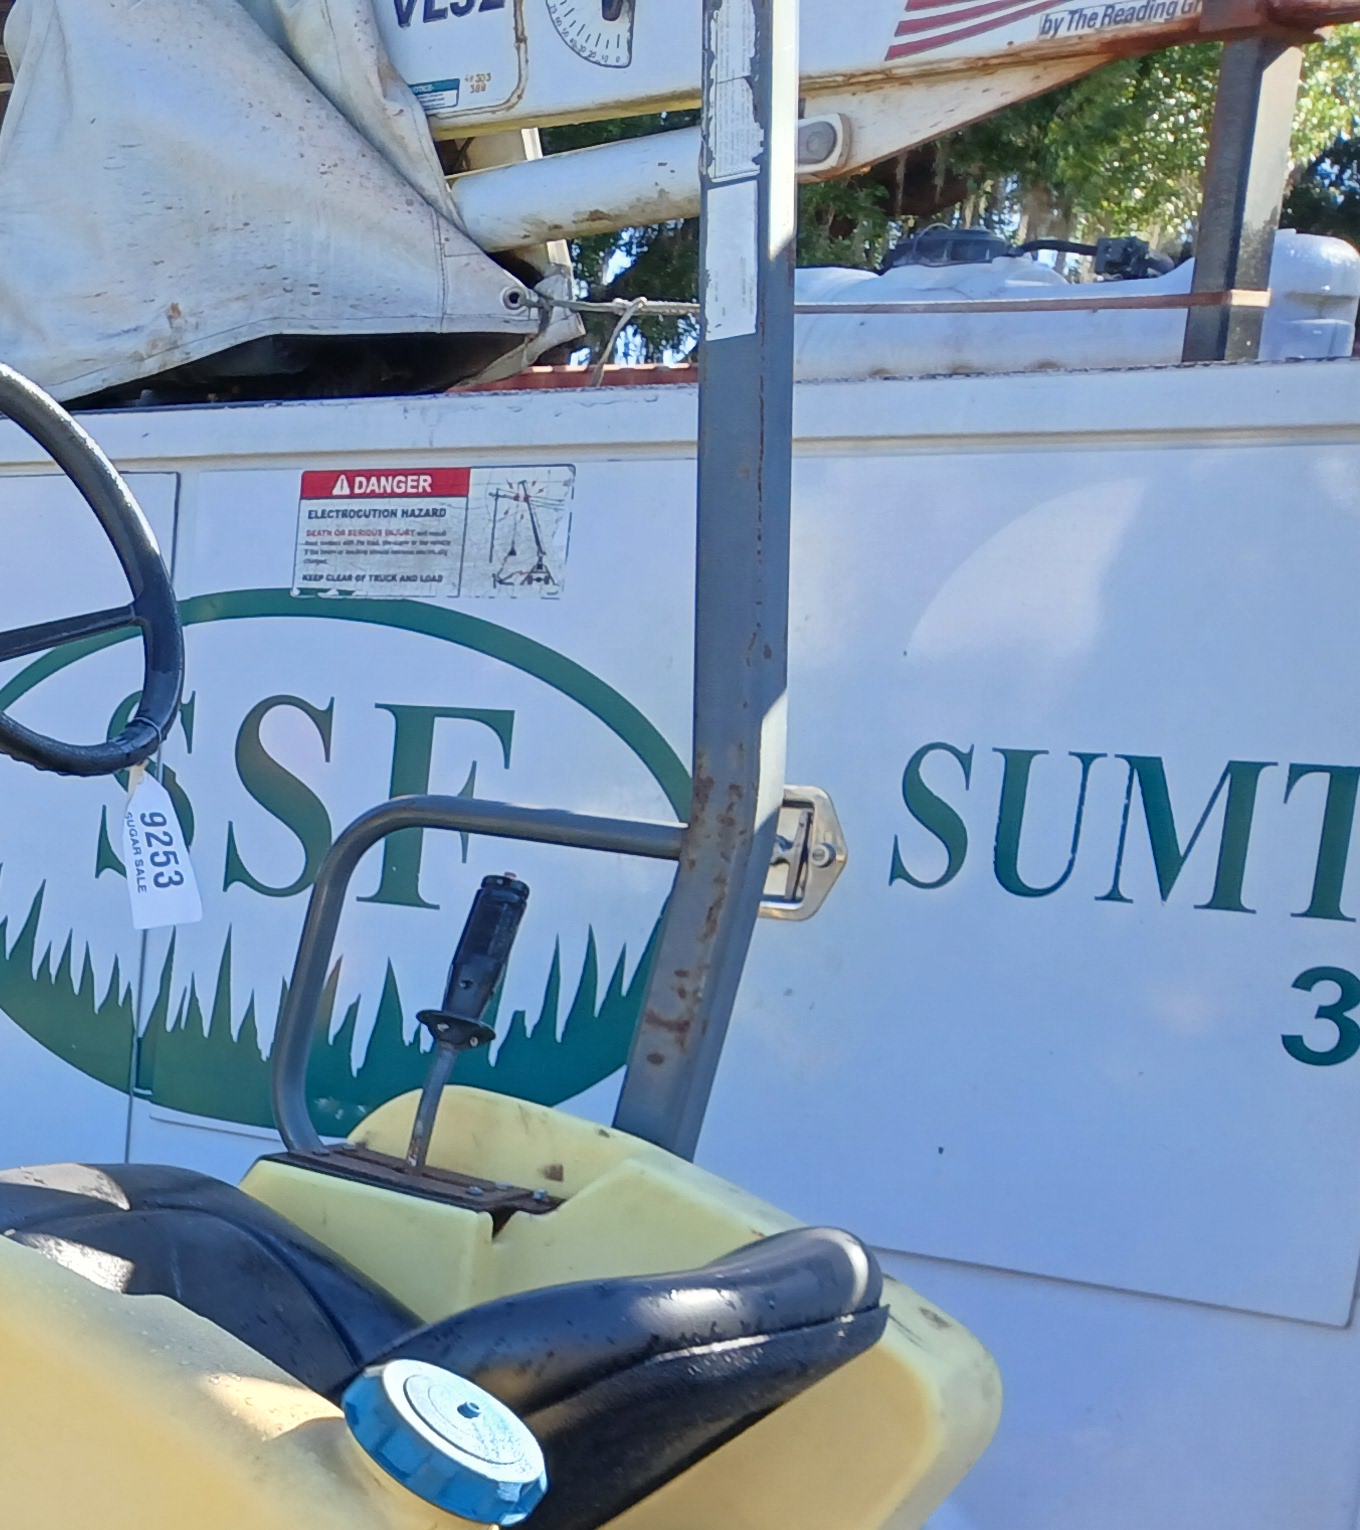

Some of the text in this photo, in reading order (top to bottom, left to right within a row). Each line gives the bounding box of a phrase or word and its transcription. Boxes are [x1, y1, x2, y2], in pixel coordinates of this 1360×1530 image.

[392, 0, 505, 28] VL
[1040, 13, 1064, 39] by
[1067, 8, 1099, 31] The
[1100, 0, 1179, 28] Reading
[353, 475, 432, 494] DANGER
[307, 508, 447, 519] ELECTROCUTION HAZARD
[385, 529, 416, 537] INJURY
[302, 574, 443, 583] KEEP CLEAR OF TRUCK AND LOAD
[124, 811, 147, 893] SUGAR SALE
[139, 811, 185, 889] 9253
[1281, 966, 1360, 1067] 3
